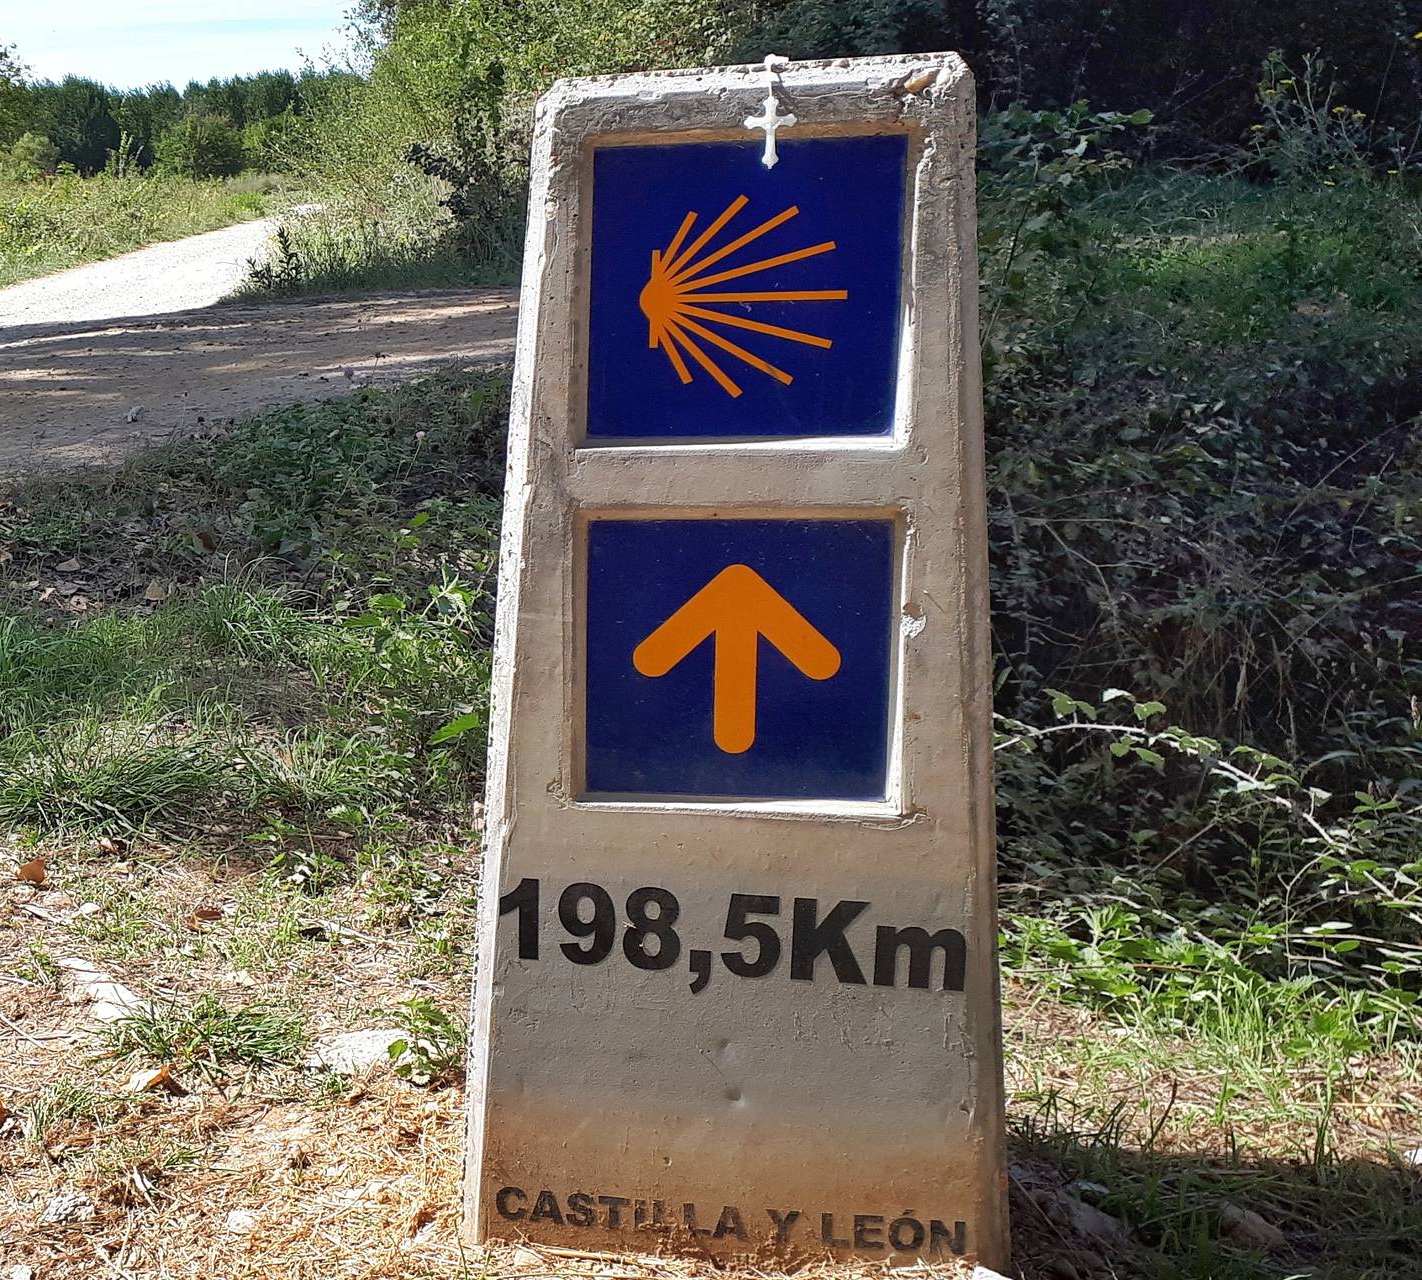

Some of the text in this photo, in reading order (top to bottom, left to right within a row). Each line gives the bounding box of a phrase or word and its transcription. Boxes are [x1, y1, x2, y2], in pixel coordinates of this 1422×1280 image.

[499, 878, 967, 994] 198,5Km
[495, 1186, 966, 1255] CASTILLA Y LEÓN
